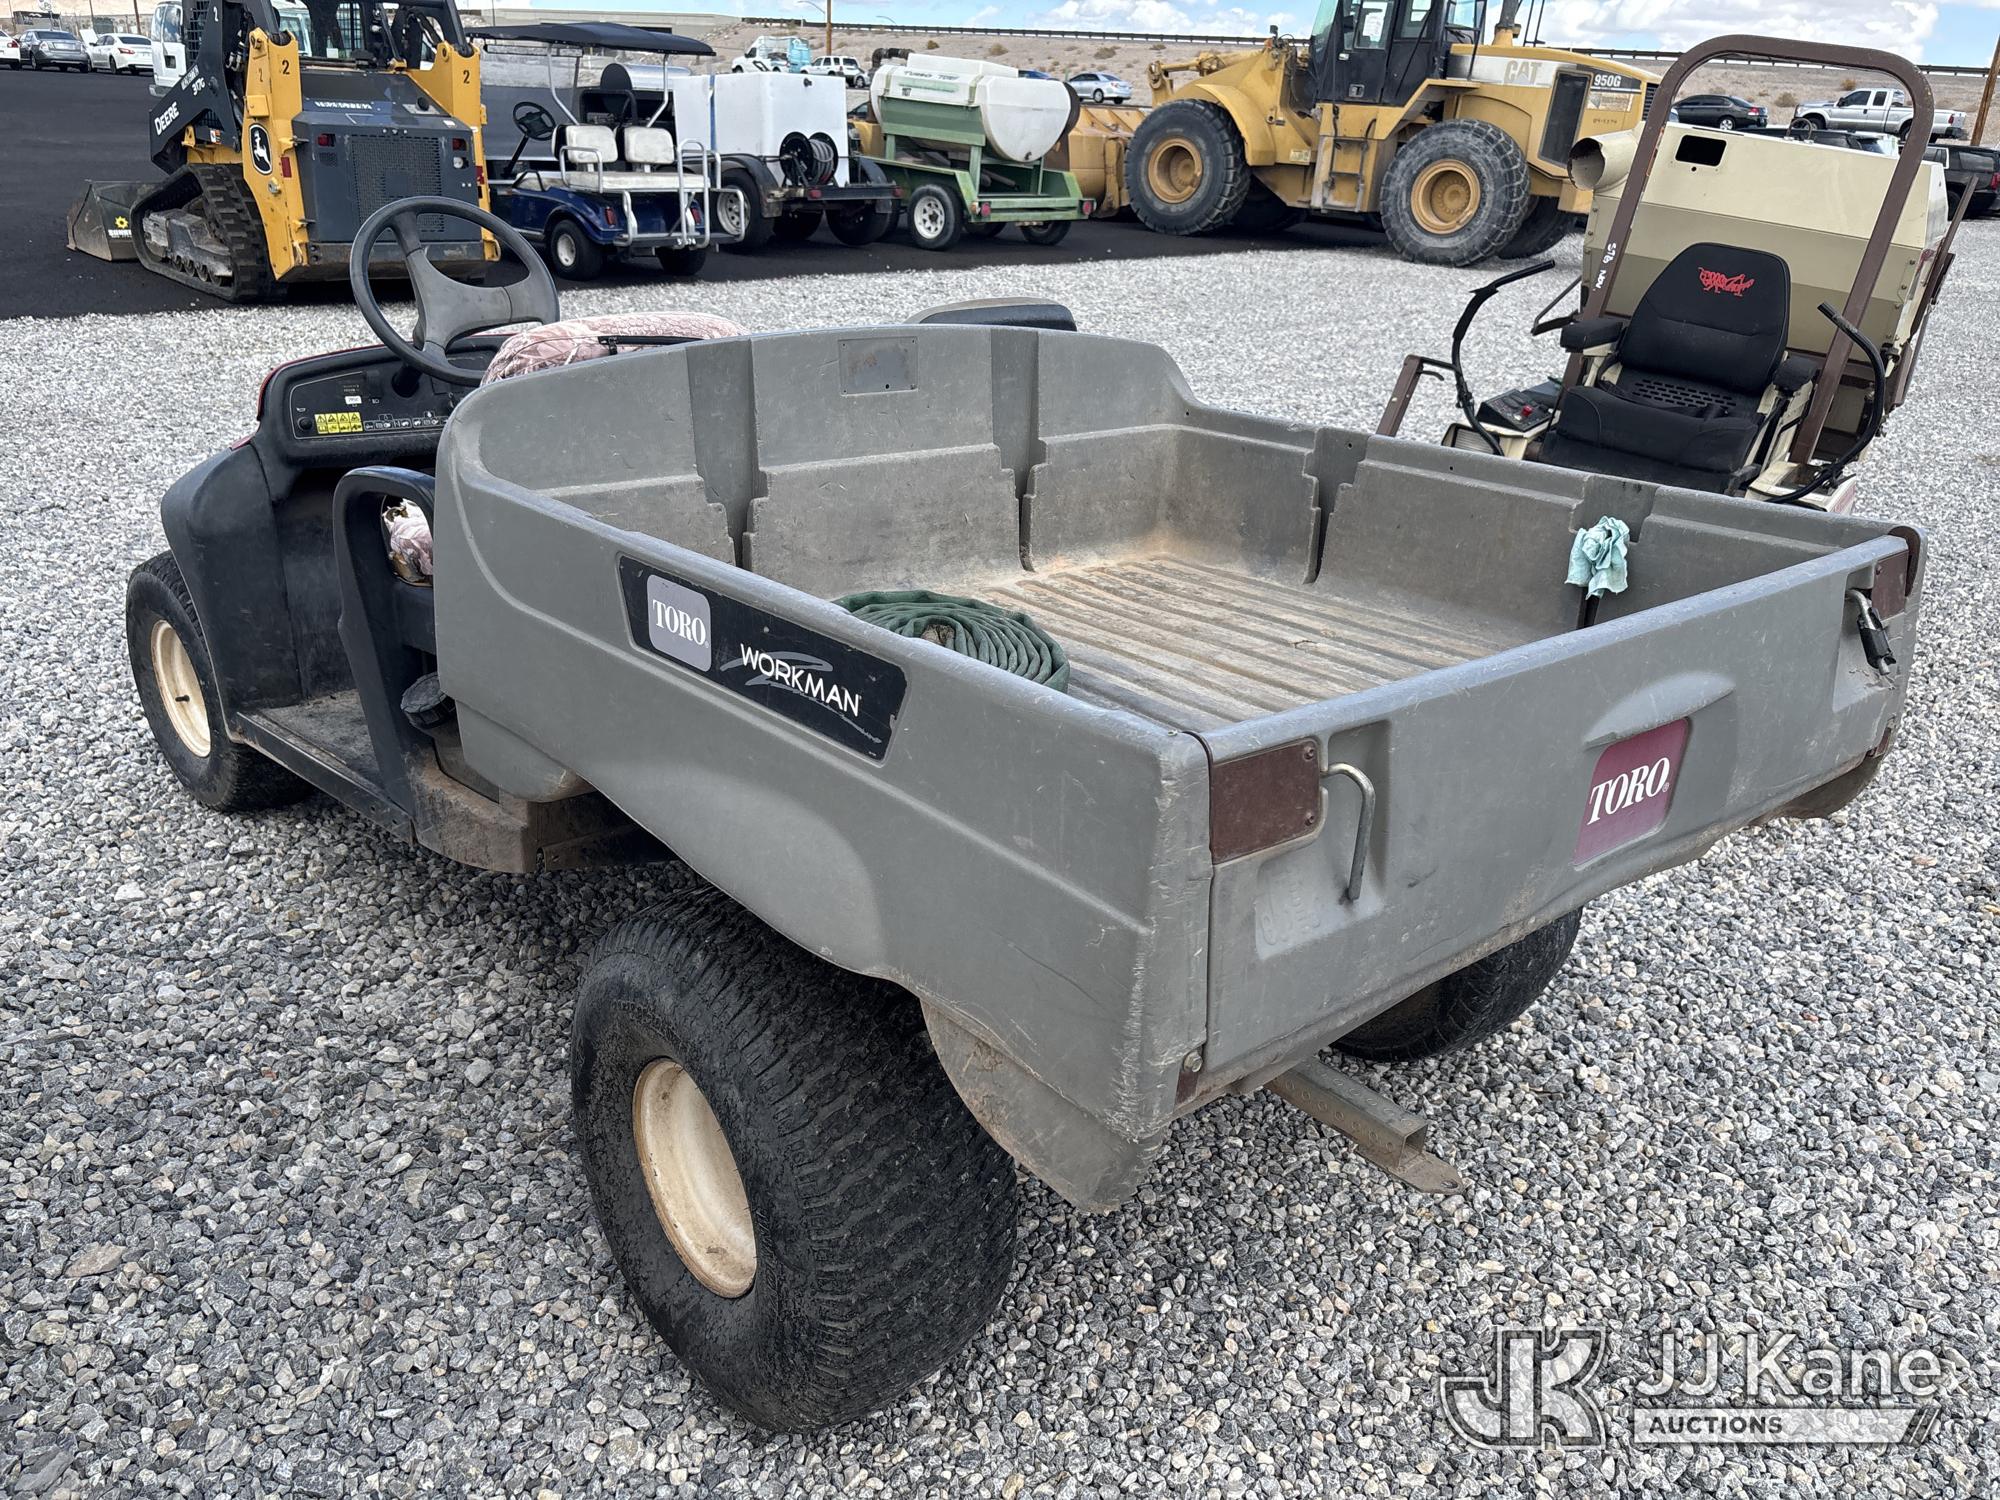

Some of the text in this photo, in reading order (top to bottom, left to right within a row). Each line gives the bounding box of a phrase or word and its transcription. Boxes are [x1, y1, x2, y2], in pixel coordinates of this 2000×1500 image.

[282, 59, 290, 75] 2
[462, 69, 470, 84] 2
[1504, 60, 1543, 85] CAT
[1594, 74, 1622, 88] 950G
[154, 101, 180, 136] DEERE
[652, 599, 862, 717] TORO WORKMAN
[1586, 757, 1670, 826] TORO
